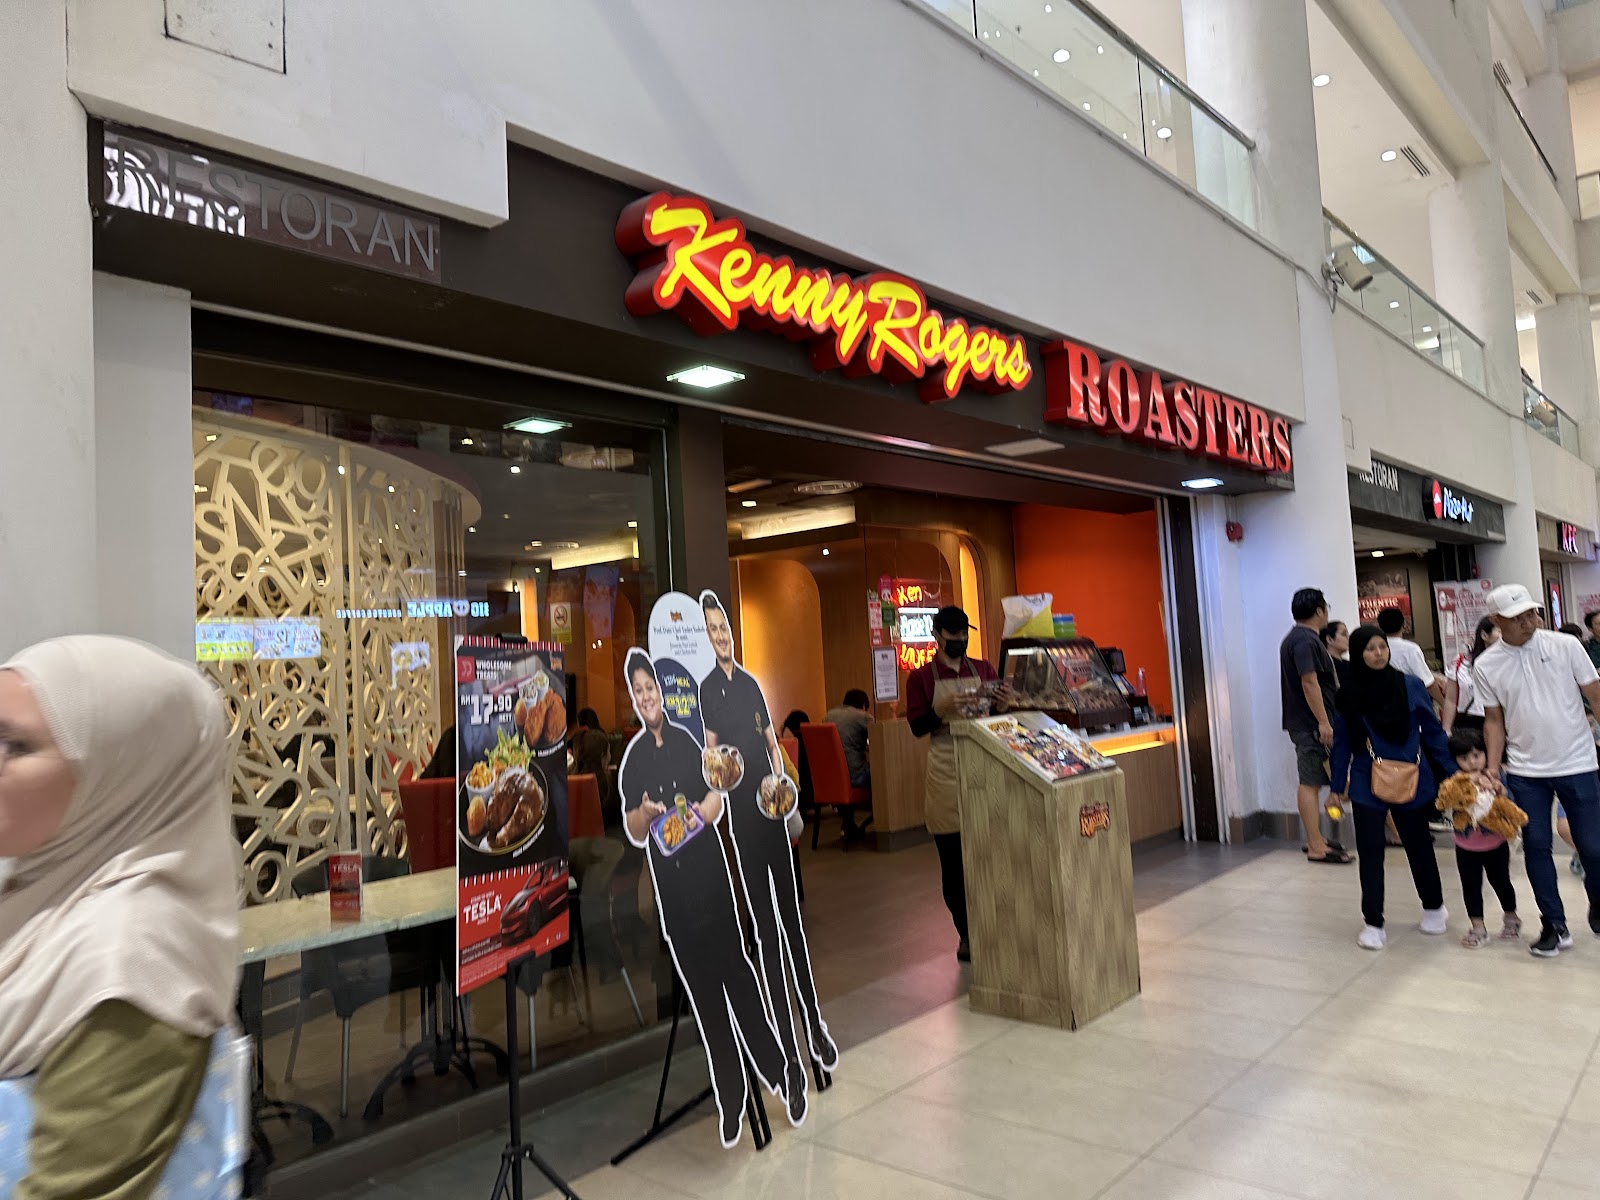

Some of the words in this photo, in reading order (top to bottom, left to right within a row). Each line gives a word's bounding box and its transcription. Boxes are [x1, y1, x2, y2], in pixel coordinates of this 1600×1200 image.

[116, 136, 436, 272] RESTORAN
[650, 203, 868, 357] Kenny
[867, 280, 1029, 391] Rogers
[1063, 339, 1292, 474] ROASTERS
[1443, 486, 1461, 519] Pizza
[1461, 496, 1474, 524] Hut
[1561, 521, 1578, 554] KFC
[1359, 597, 1398, 609] THENTIC
[475, 659, 512, 671] WHOLESOME
